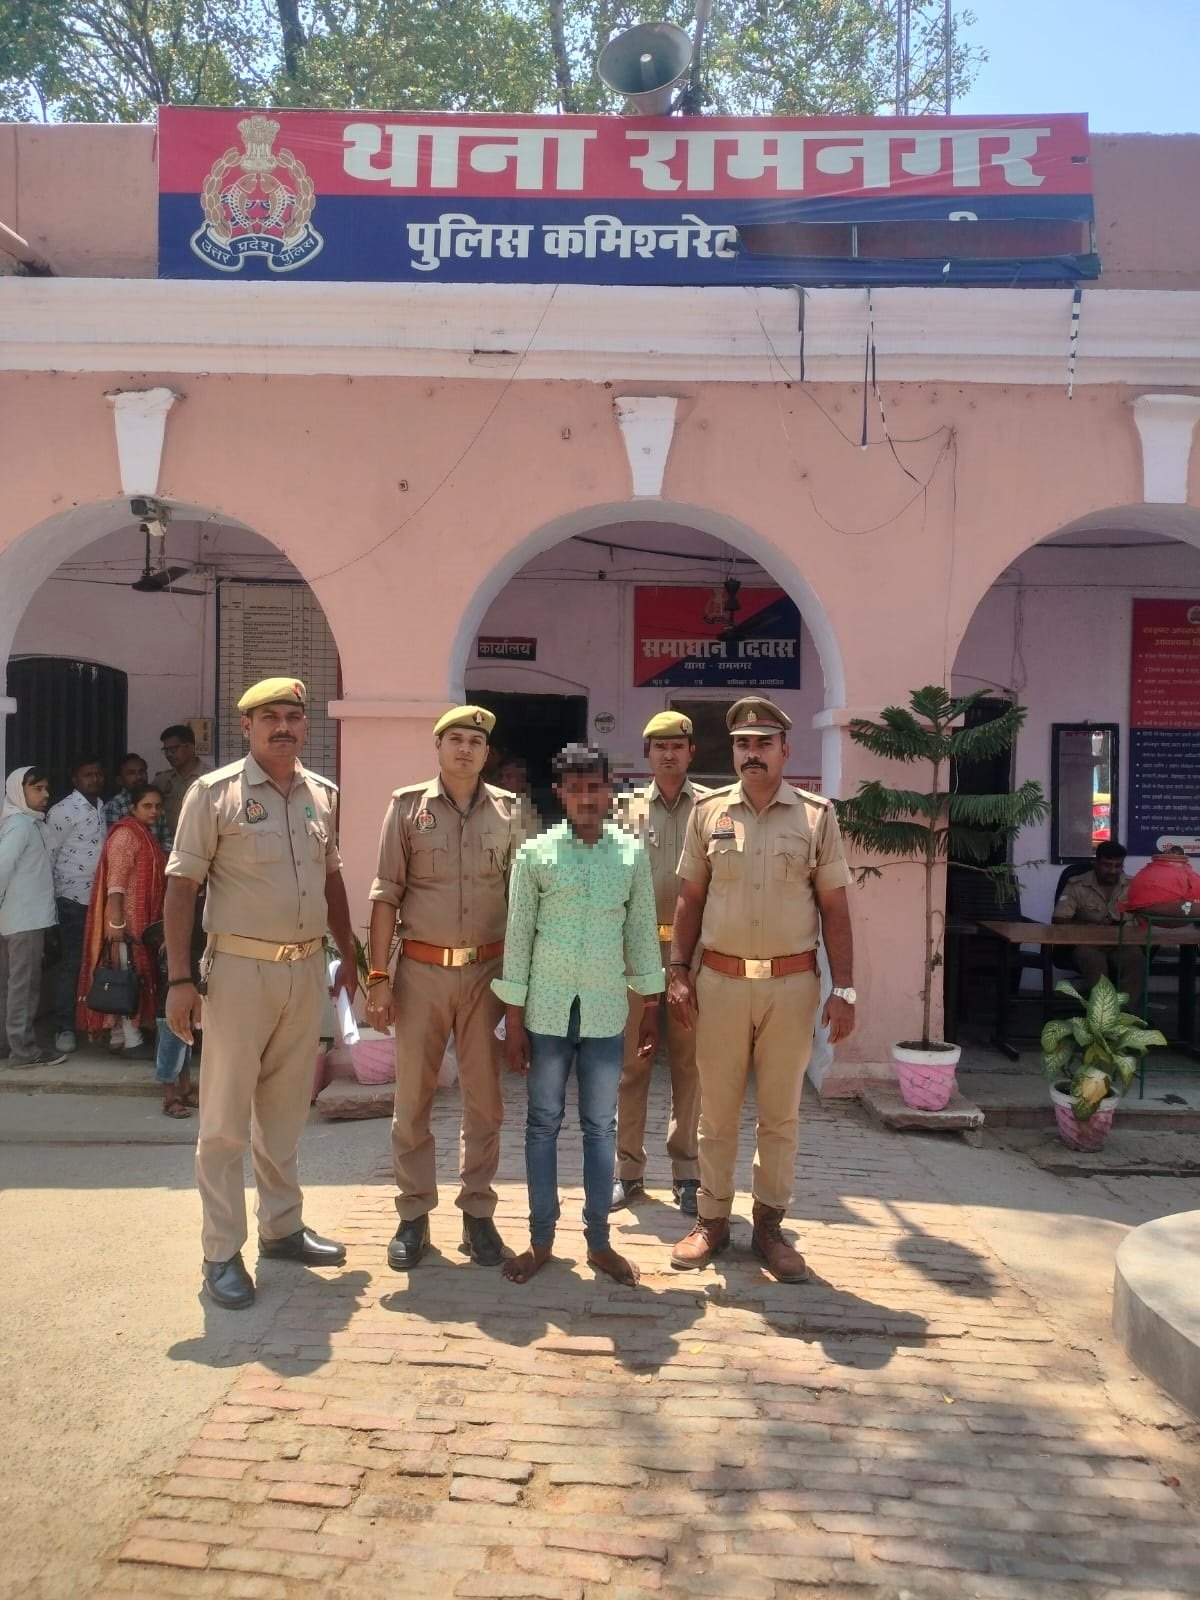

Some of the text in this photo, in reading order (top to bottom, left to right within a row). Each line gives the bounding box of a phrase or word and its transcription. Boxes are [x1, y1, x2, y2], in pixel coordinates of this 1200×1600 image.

[343, 123, 1050, 191] थाना रामनगर
[202, 237, 315, 266] उत्तर प्रदेश पुलिस
[407, 213, 739, 271] पुलिस कमिश्नरेट
[480, 640, 531, 655] कार्यालय
[640, 639, 728, 658] समाधान
[717, 662, 752, 670] रामनगर
